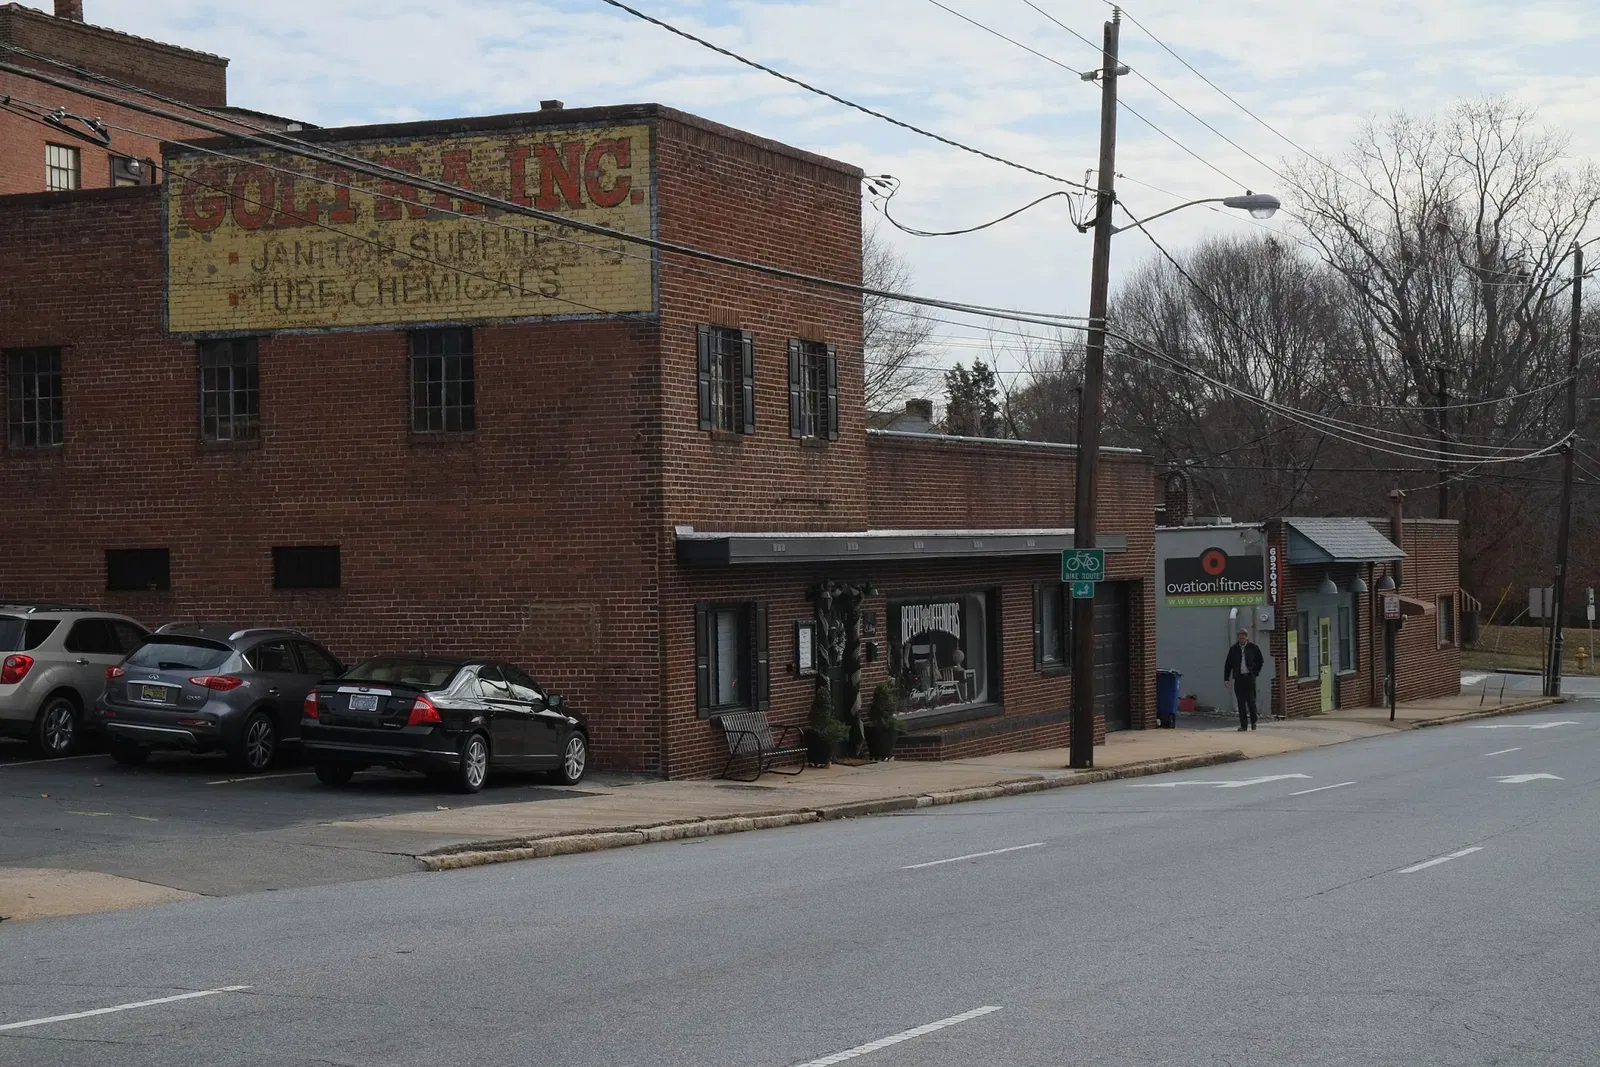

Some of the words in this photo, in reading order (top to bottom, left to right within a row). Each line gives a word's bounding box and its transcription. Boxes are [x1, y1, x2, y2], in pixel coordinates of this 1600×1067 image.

[505, 137, 645, 210] INC.
[351, 266, 563, 308] CHEMICALS
[1065, 572, 1080, 580] BIKE
[1081, 572, 1101, 580] ROUTE
[901, 605, 923, 645] REPEAT
[929, 602, 960, 640] OFFENDERS
